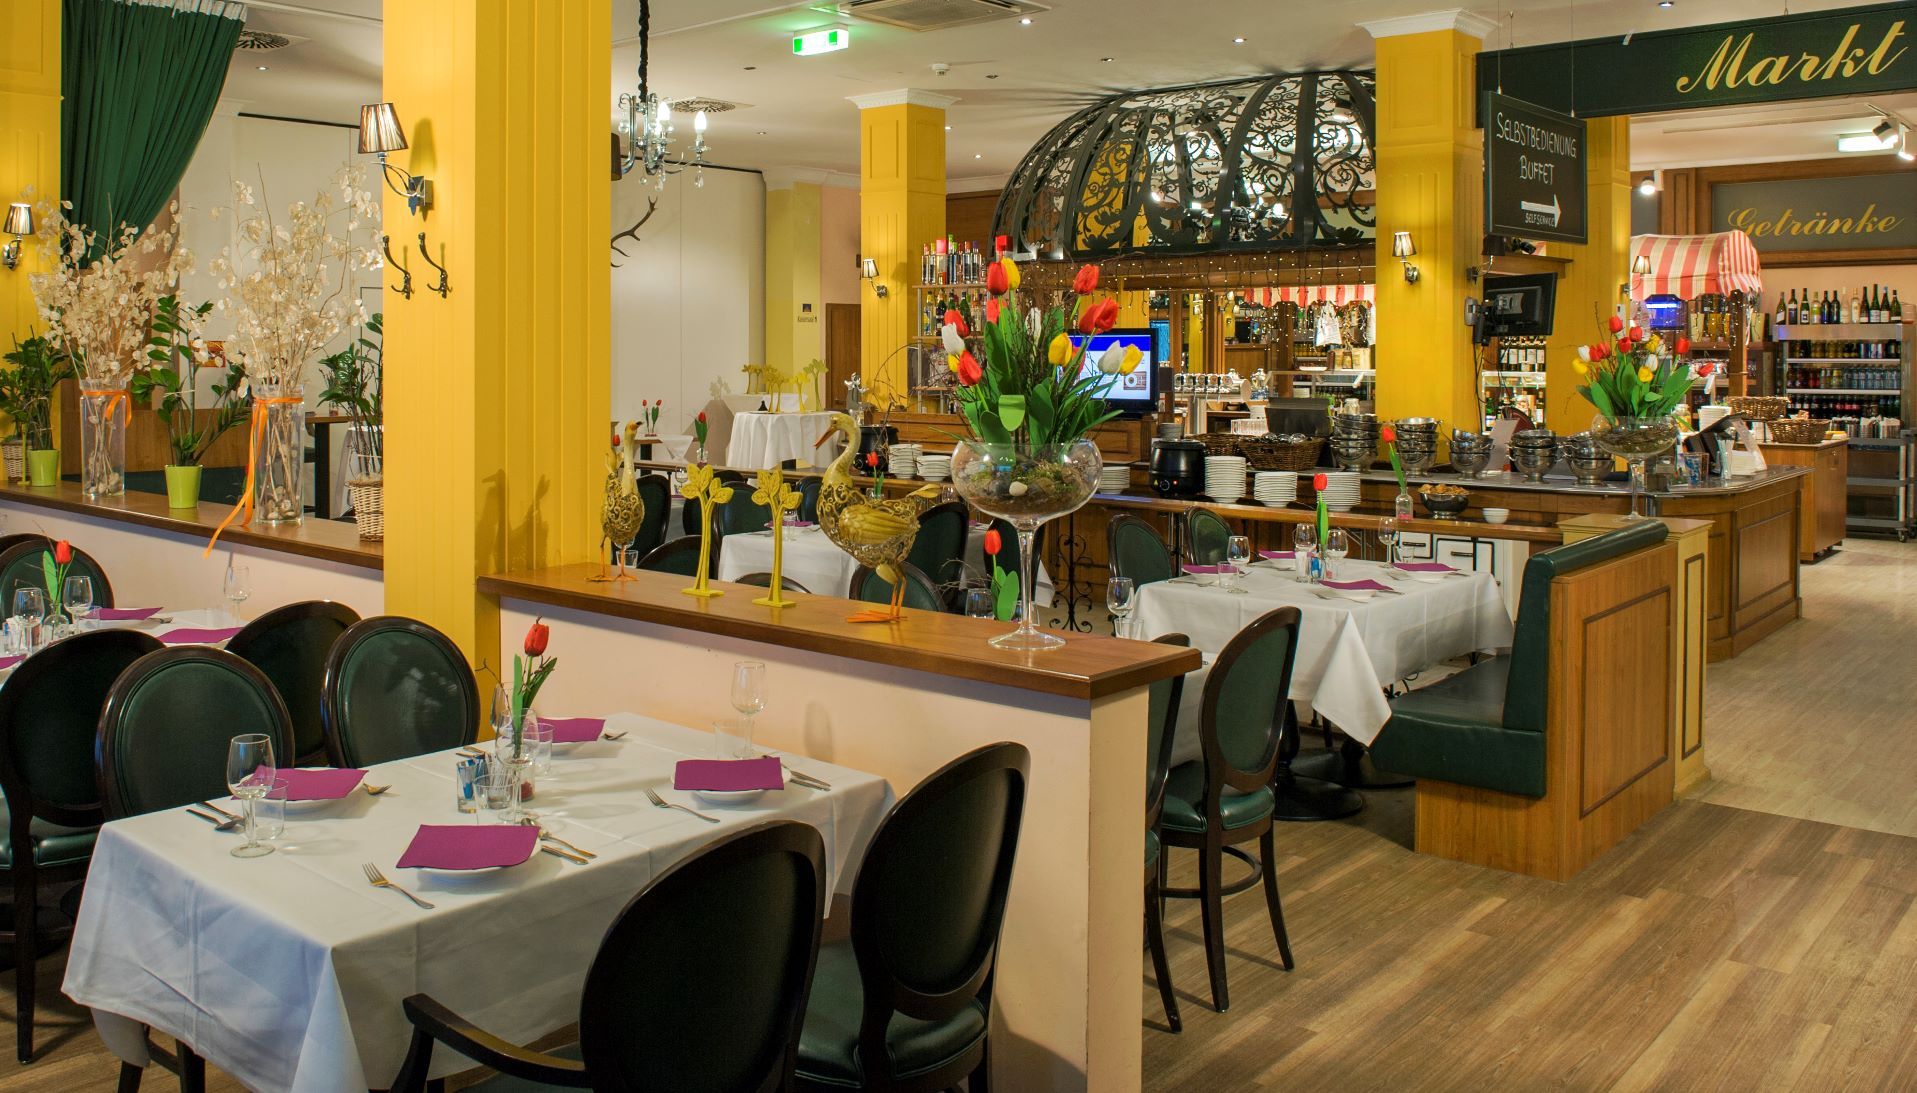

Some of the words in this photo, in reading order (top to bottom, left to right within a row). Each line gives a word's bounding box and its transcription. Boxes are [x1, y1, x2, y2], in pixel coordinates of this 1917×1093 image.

[1676, 20, 1909, 93] Markt
[1496, 112, 1577, 158] SELBSTBEDIENUNG
[1519, 155, 1555, 185] BUFFET
[1727, 203, 1905, 237] Getränke
